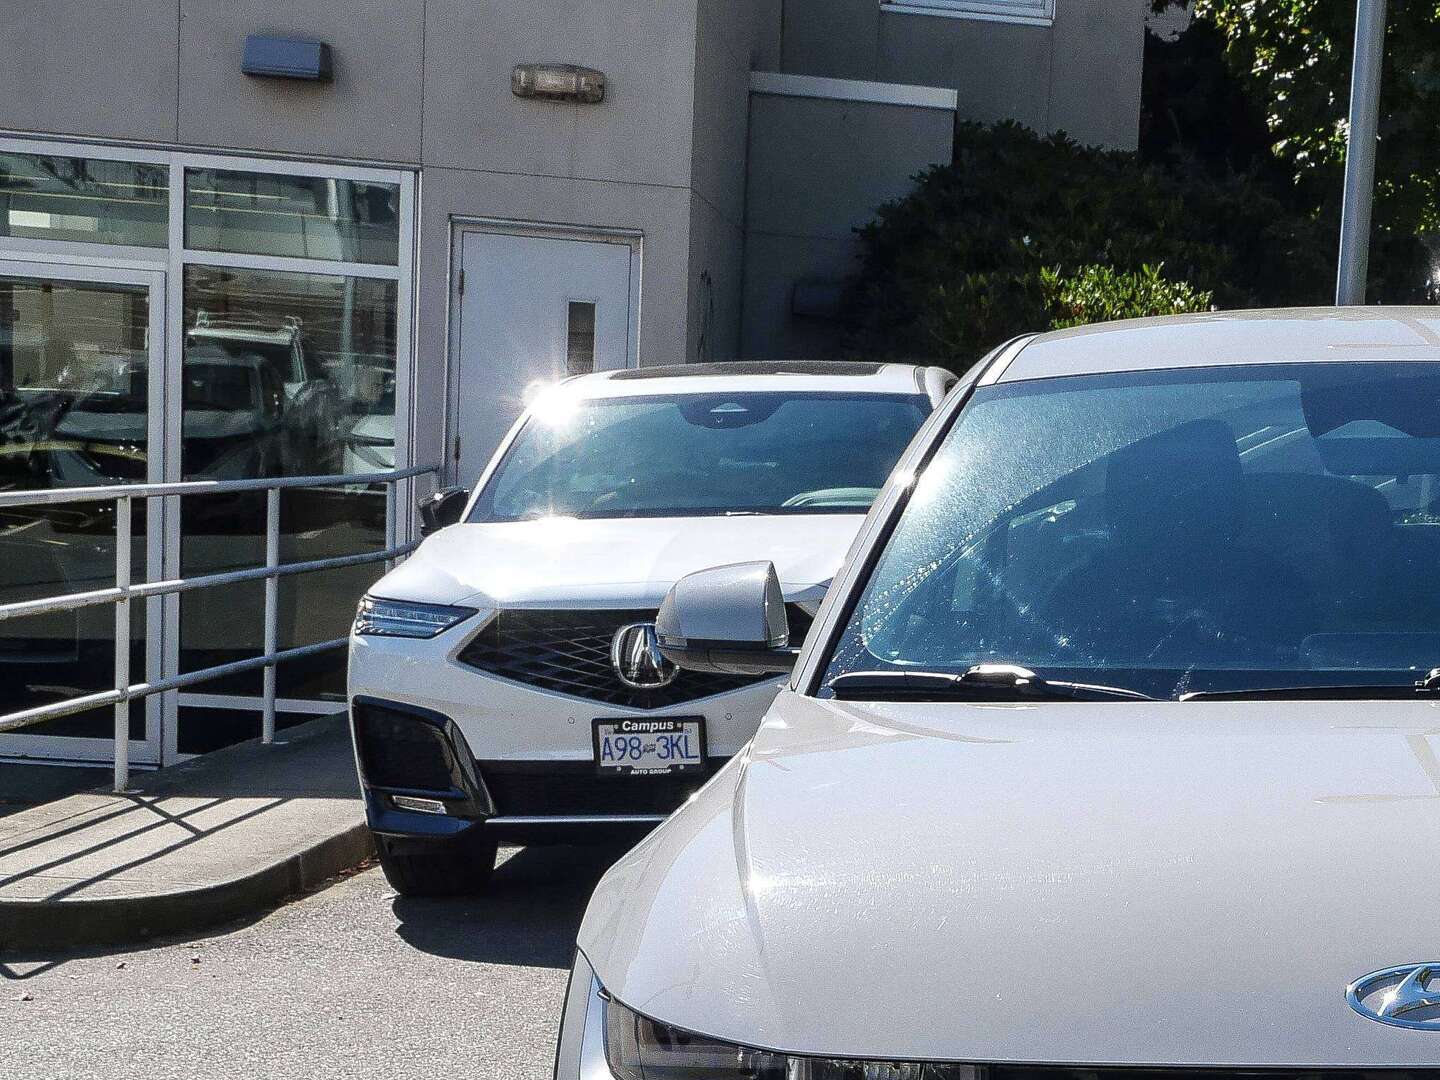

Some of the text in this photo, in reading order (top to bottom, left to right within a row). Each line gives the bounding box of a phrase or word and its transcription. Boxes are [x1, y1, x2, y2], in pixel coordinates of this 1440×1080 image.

[622, 720, 674, 732] Campus
[602, 735, 699, 761] A98 3KL
